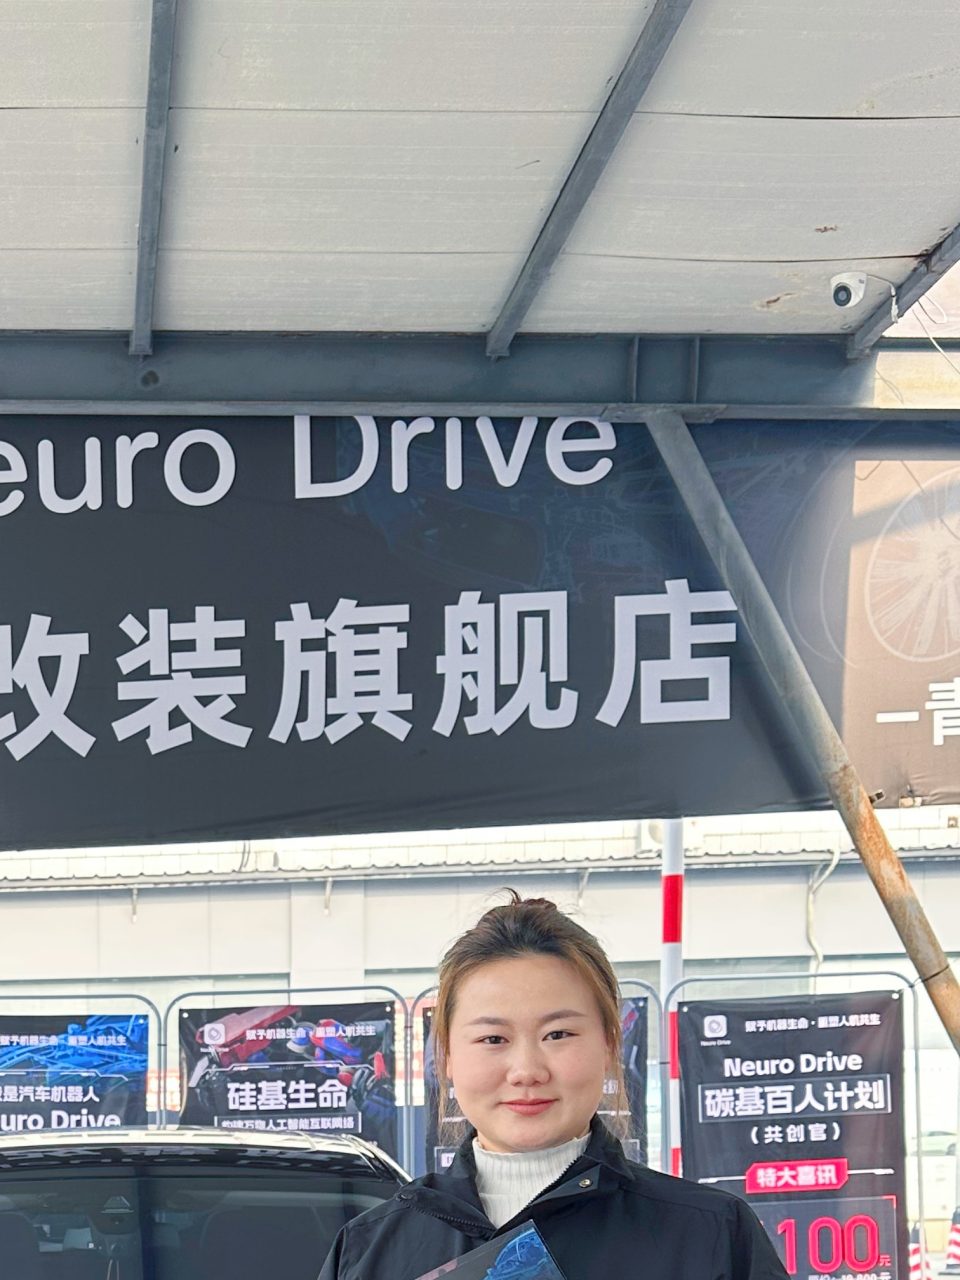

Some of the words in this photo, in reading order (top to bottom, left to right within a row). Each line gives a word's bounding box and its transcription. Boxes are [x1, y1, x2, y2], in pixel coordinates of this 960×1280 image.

[293, 415, 617, 499] Drive
[723, 1057, 795, 1078] Neuro
[799, 1051, 863, 1073] Drive
[226, 1078, 349, 1111] 硅基生命
[704, 1079, 885, 1118] 碳基百人计划
[50, 1108, 121, 1131] Drive
[756, 1164, 838, 1188] 特大喜讯
